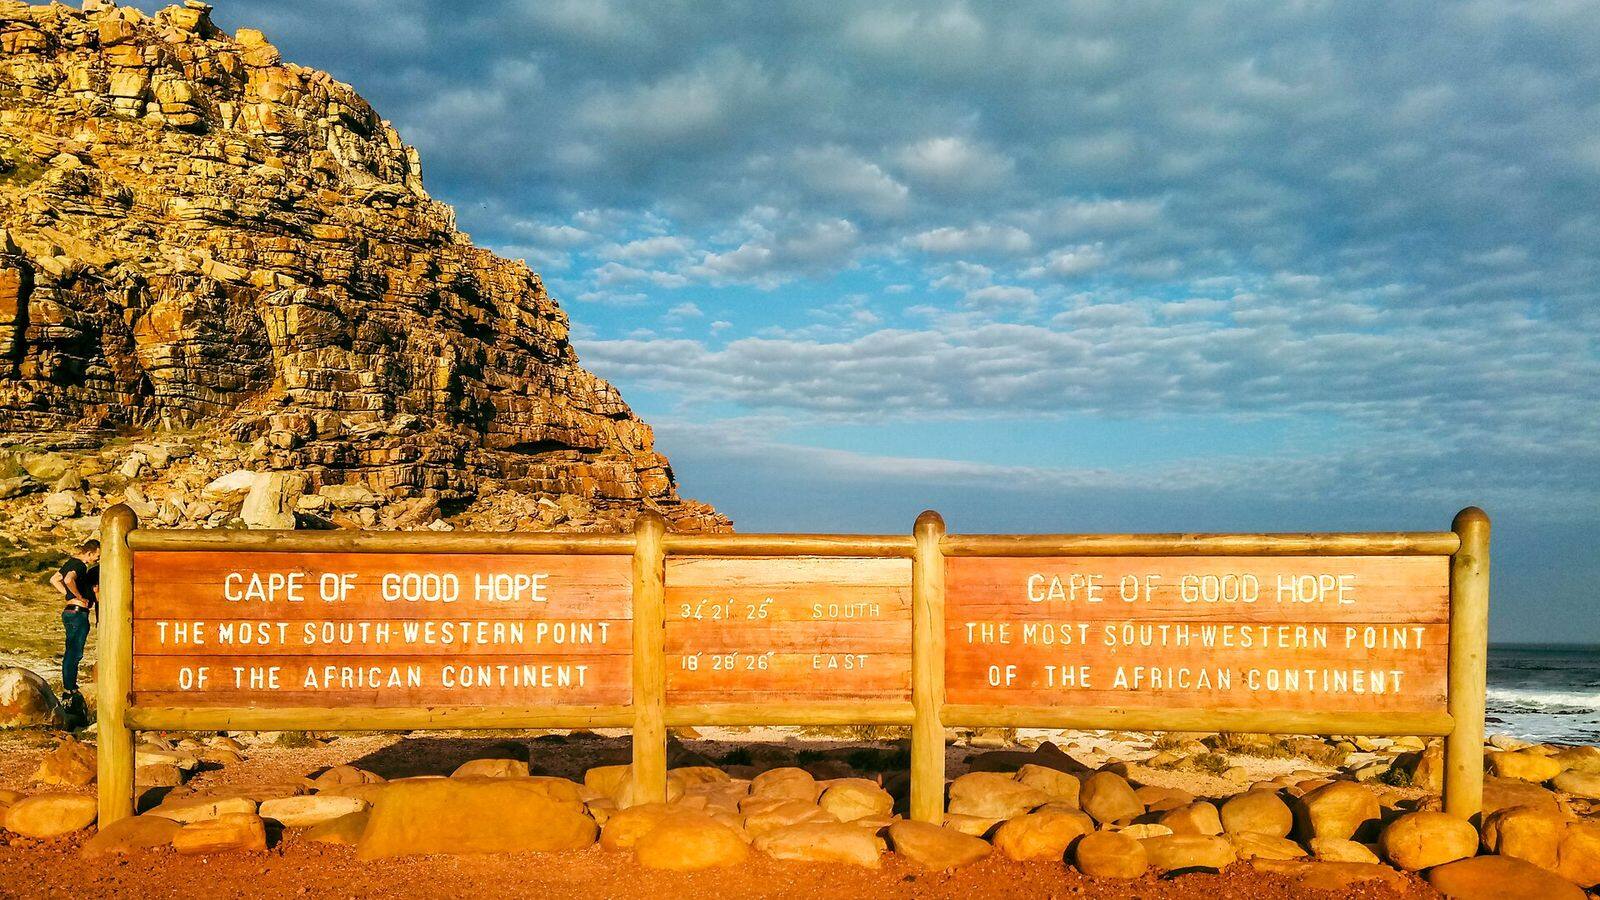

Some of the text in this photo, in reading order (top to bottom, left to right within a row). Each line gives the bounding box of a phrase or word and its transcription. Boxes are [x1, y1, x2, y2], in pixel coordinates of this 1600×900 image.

[224, 572, 549, 603] CAPE OF GOOD HOPE
[1027, 573, 1357, 605] CAPE OF GOOD HOPE
[812, 603, 880, 619] SOUTH
[157, 621, 611, 645] THE MOST SOUTH-WESTERN POINT
[965, 622, 1427, 650] THE MOST SOUTH-WESTERN POINT
[812, 653, 870, 670] EAST
[178, 665, 589, 690] OF THE AFRICAN CONTINENT
[987, 664, 1406, 694] OF THE AFRICAN CONTINENT
